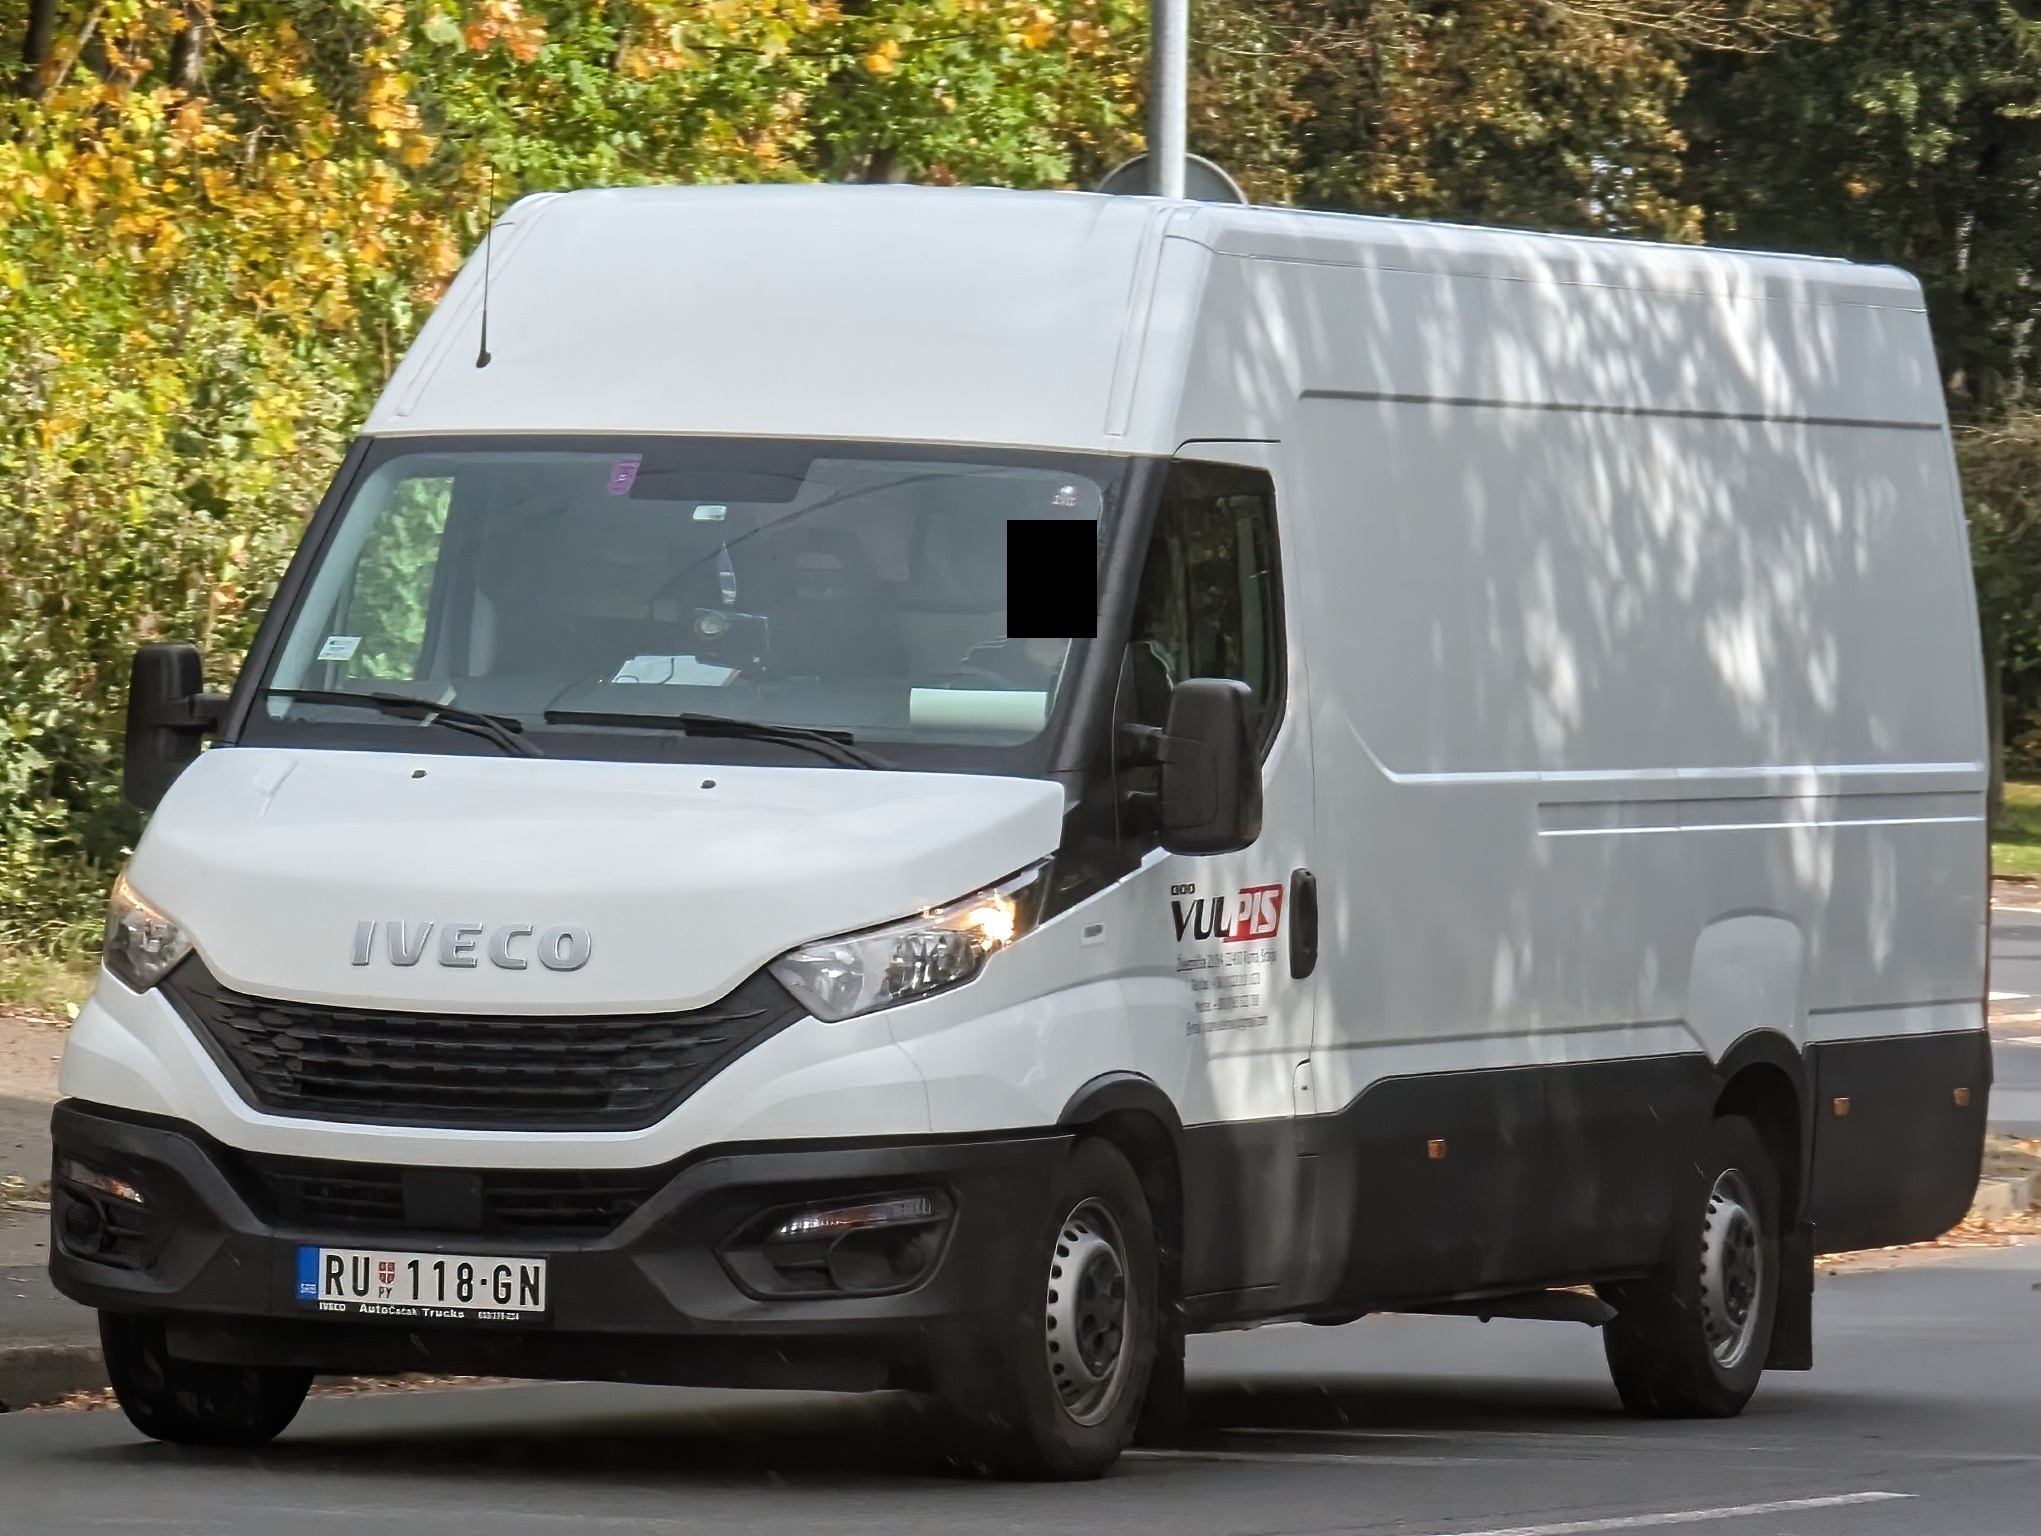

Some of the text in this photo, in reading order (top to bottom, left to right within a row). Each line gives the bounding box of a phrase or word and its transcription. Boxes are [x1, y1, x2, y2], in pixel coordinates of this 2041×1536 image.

[1171, 888, 1281, 942] VULPIS
[352, 920, 592, 971] IVECO
[325, 1254, 370, 1297] RU
[319, 1302, 346, 1312] IVECO
[423, 1308, 465, 1319] Trucks
